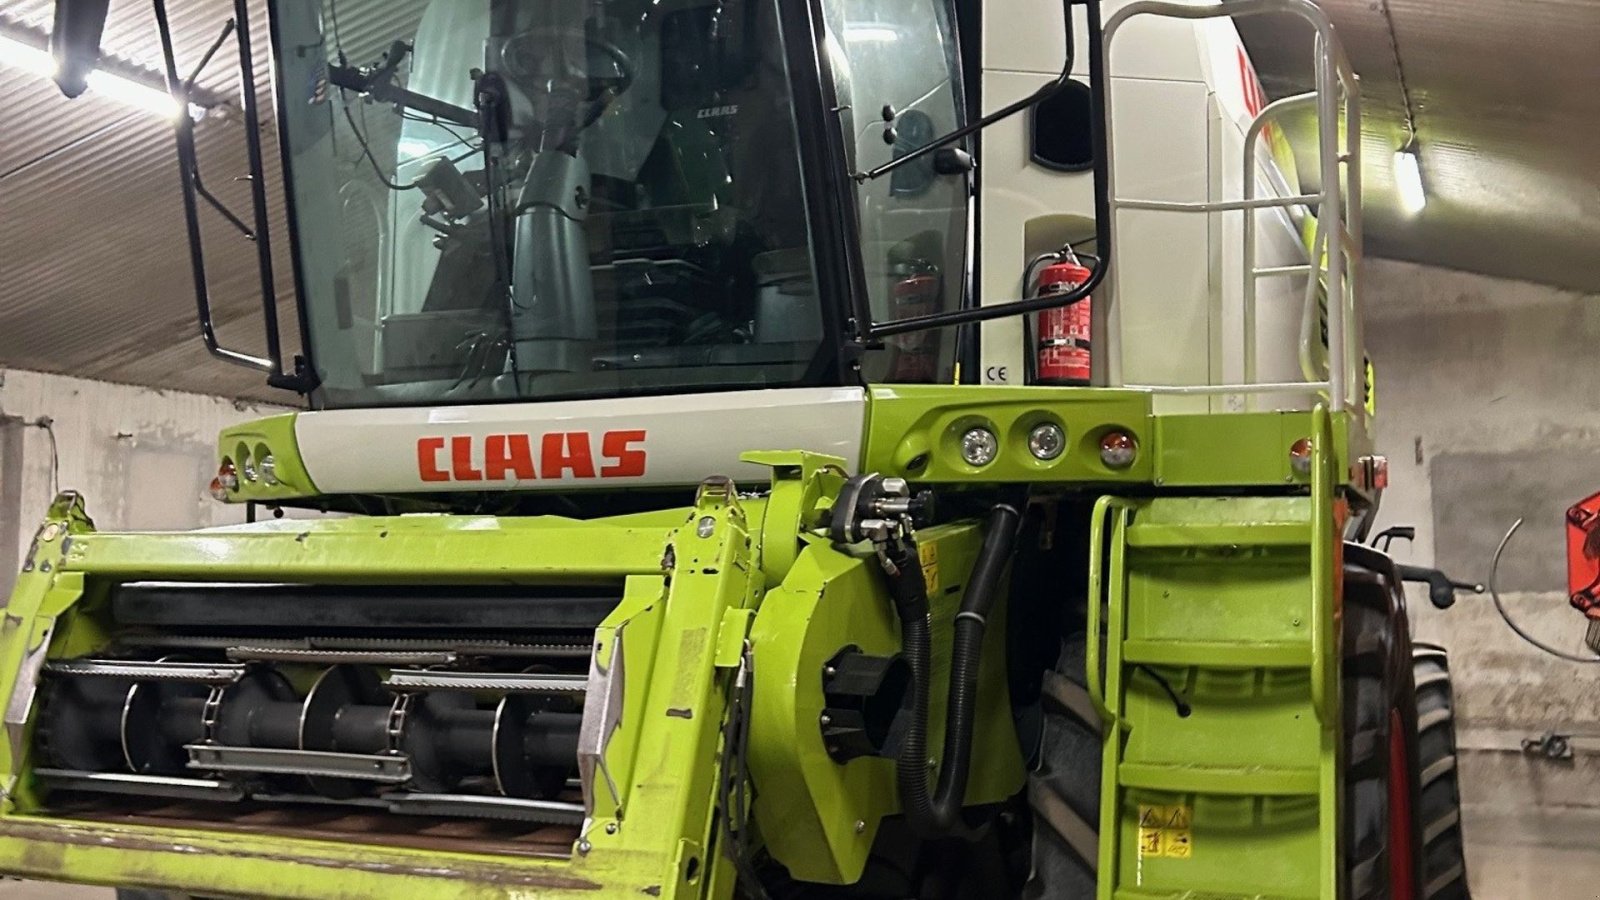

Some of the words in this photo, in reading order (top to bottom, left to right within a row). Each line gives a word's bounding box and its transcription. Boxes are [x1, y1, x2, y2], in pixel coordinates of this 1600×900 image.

[697, 104, 739, 119] CLAAS
[986, 366, 1007, 382] CE
[417, 430, 646, 482] CLAAS
